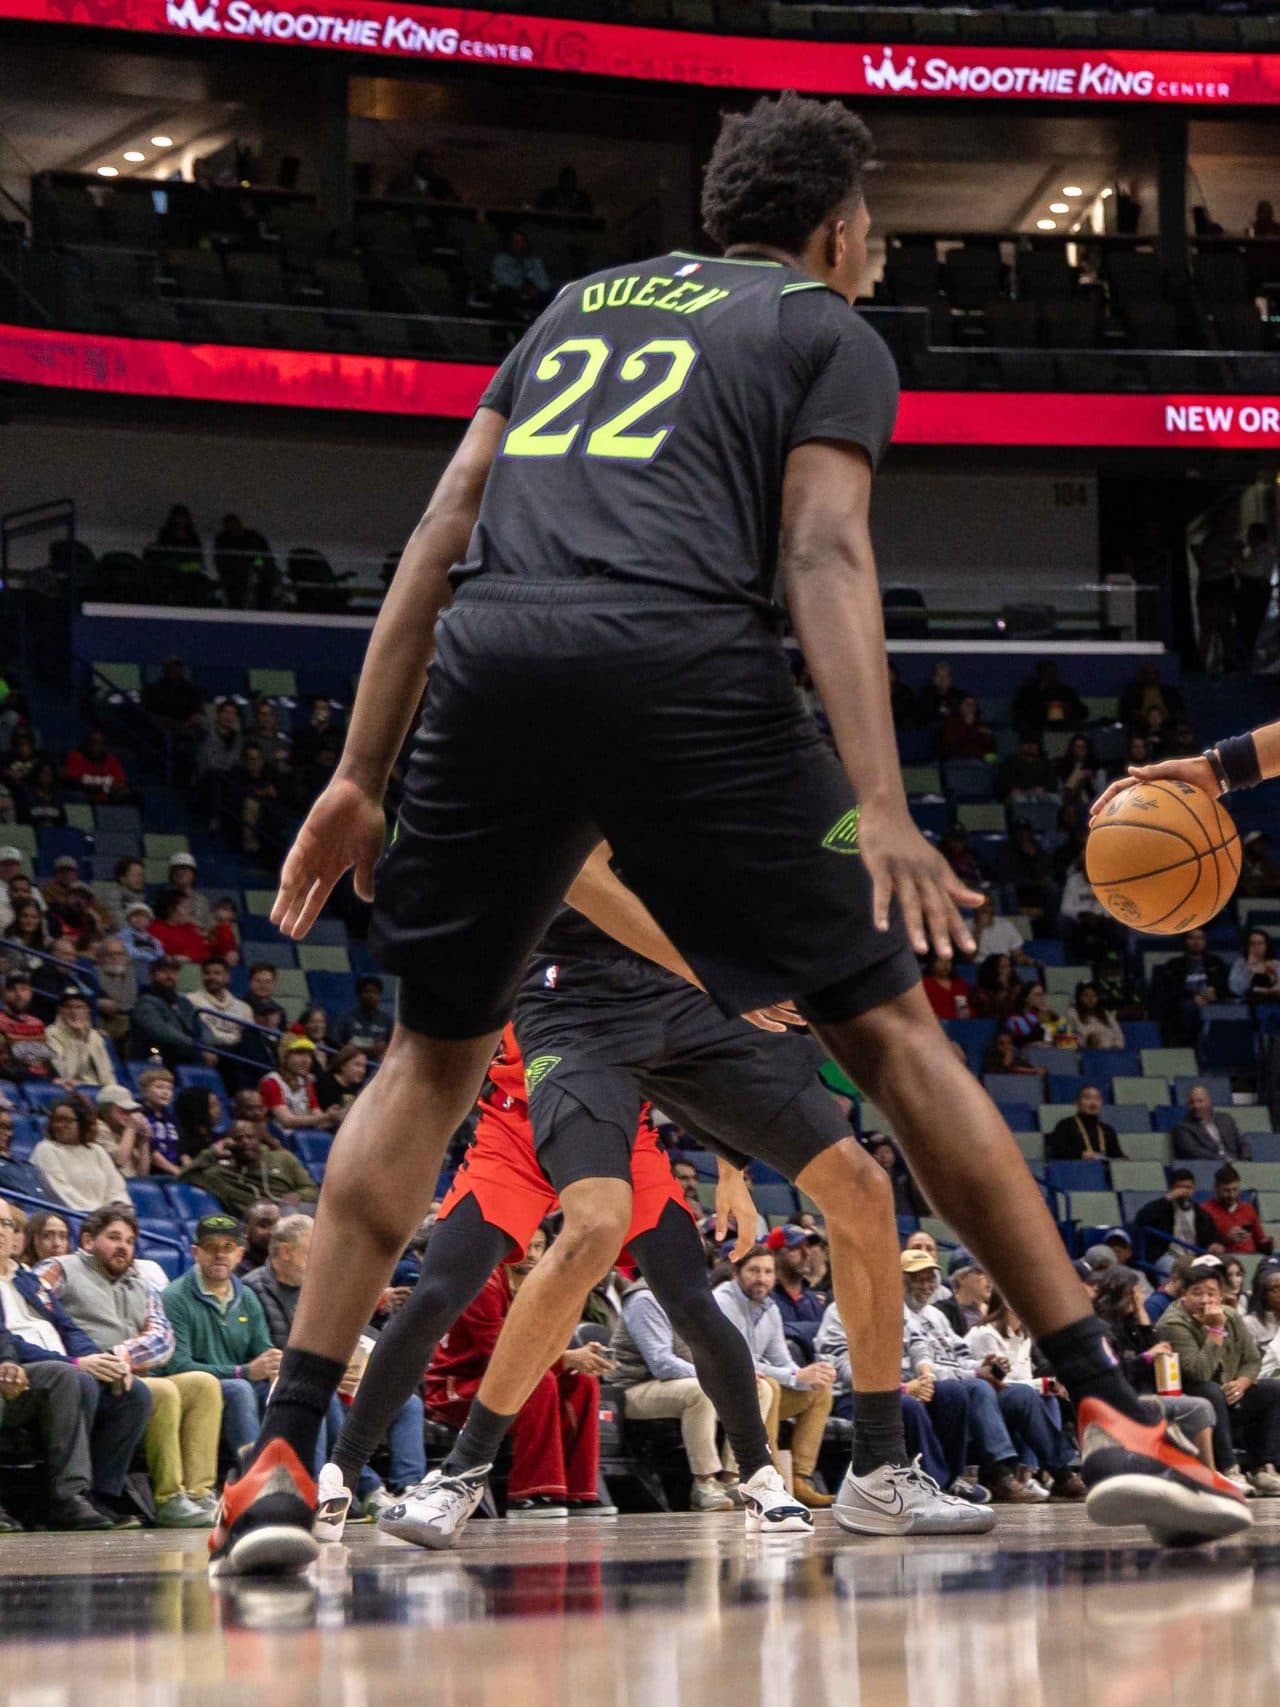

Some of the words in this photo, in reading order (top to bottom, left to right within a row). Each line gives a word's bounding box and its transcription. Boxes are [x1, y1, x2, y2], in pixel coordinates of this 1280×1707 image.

[223, 0, 378, 46] SMOOTHIE
[460, 40, 533, 61] CENTER
[920, 58, 1076, 93] SMOOTHIE
[1157, 81, 1230, 98] CENTER
[582, 276, 730, 314] QUEEN
[500, 336, 699, 462] 22
[1165, 406, 1235, 432] NEW
